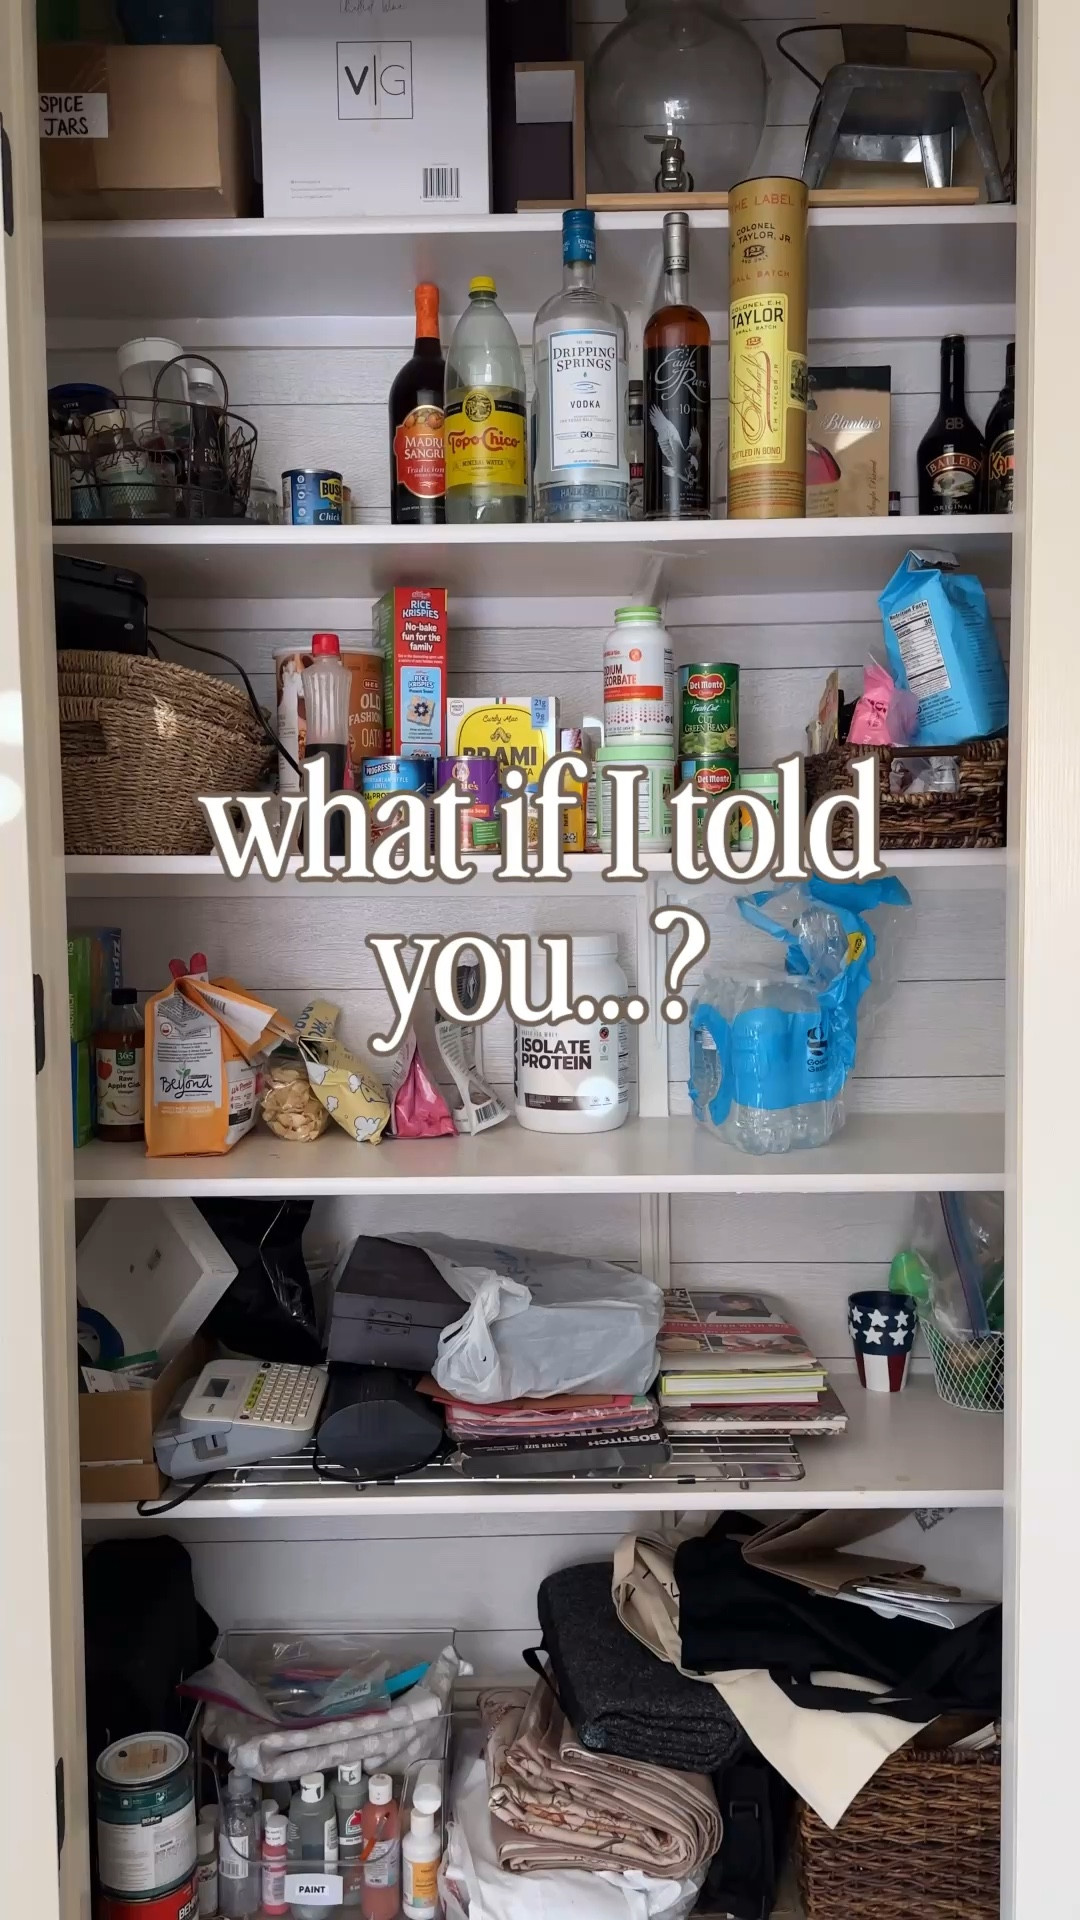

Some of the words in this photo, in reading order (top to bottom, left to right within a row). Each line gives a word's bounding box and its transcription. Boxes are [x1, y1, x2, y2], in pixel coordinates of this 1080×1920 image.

[40, 95, 84, 113] SPICE
[44, 117, 88, 136] JARS
[755, 193, 795, 206] LABEL
[736, 222, 776, 237] COLONEL
[739, 231, 776, 245] TAYLOR,
[756, 270, 791, 278] BATCH
[731, 301, 764, 314] COLONEL
[731, 307, 784, 329] TAYLOR
[735, 328, 752, 336] SMALL
[553, 346, 616, 360] DRIPPING
[556, 358, 612, 373] SPRINGS
[570, 400, 601, 409] VODKA
[679, 403, 691, 415] 10
[825, 412, 881, 431] Blanton's
[405, 435, 443, 449] MADRI
[448, 429, 481, 454] Topo
[482, 427, 520, 452] Chico
[404, 448, 444, 460] SANGRI
[732, 449, 753, 459] BOTTLED
[753, 447, 761, 456] IN
[763, 446, 781, 455] BOND
[406, 465, 445, 474] Tradicion
[929, 455, 978, 473] BAILEYS
[322, 482, 342, 495] BUS
[933, 503, 972, 512] ORIGINAL
[410, 600, 431, 610] RICE
[889, 606, 912, 621] Nutrition
[912, 600, 928, 612] Facts
[402, 609, 439, 619] KRISPIES
[405, 622, 437, 632] No-bake
[923, 618, 932, 626] 30
[402, 632, 415, 641] fun
[415, 632, 427, 641] for
[428, 633, 441, 642] the
[409, 642, 433, 652] family
[604, 663, 623, 675] ODIUM
[604, 674, 637, 688] SCORBATE
[690, 682, 700, 690] Del
[701, 681, 723, 689] Monte
[360, 693, 381, 710] OLD
[534, 699, 546, 708] 21g
[536, 712, 545, 721] 9g
[697, 716, 713, 724] CUT
[685, 724, 705, 733] GREEN
[707, 723, 728, 732] BEANS
[366, 762, 396, 776] PROGRESSO
[697, 775, 708, 783] Del
[709, 774, 730, 783] Monte
[112, 940, 121, 988] Ziplo
[521, 1038, 590, 1054] ISOLATE
[118, 1052, 134, 1060] 365
[521, 1053, 592, 1070] PROTEIN
[107, 1082, 126, 1090] Apple
[160, 1075, 213, 1099] Beyond
[587, 1432, 661, 1447] BOSTITCH
